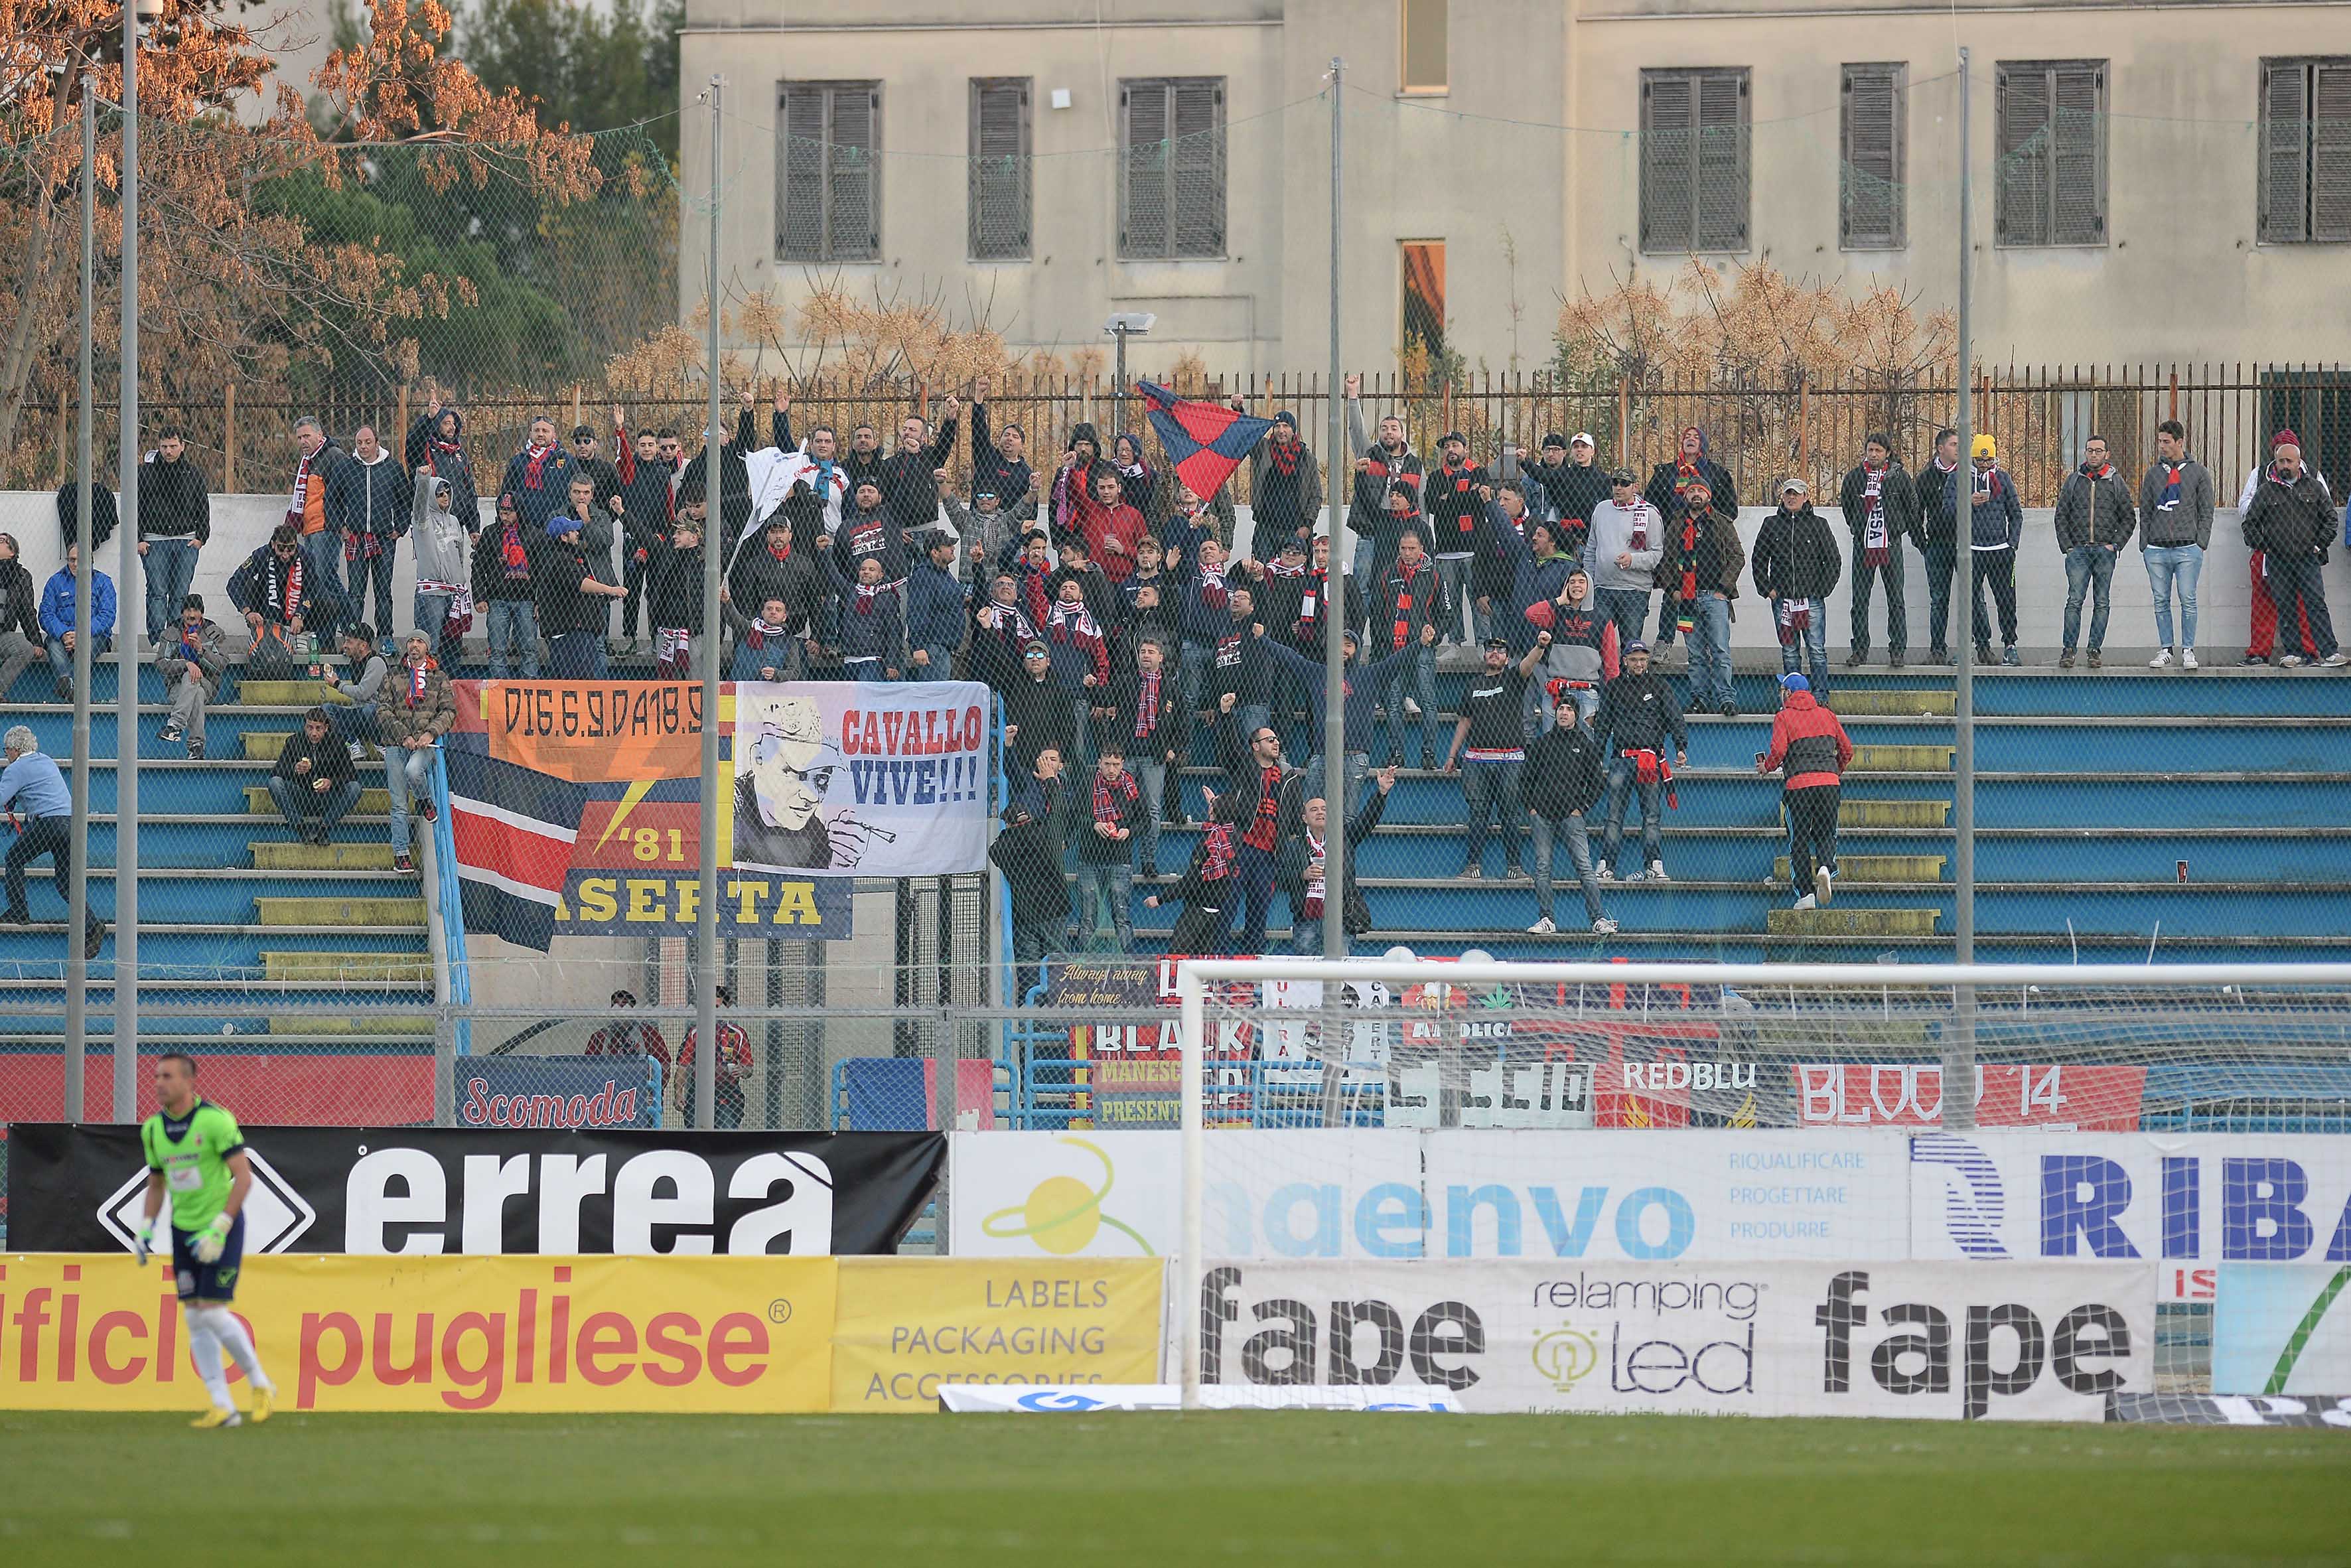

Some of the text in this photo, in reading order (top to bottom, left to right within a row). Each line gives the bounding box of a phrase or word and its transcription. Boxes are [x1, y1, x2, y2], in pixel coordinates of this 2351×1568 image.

[841, 705, 982, 756] CAVALLO
[851, 755, 977, 806] VIVE!!!
[1057, 987, 1086, 1006] from
[1060, 964, 1147, 985] Always away
[1096, 1019, 1246, 1052] BLAK
[463, 1078, 637, 1128] Scomoda
[1729, 1151, 1866, 1171] RIQUALIFICARE
[1730, 1186, 1848, 1204] PROGETTARE
[2040, 1155, 2351, 1262] RIB
[1731, 1221, 1830, 1239] PRODURRE
[986, 1279, 1108, 1309] LABELS
[1533, 1271, 1758, 1320] relamping
[296, 1265, 770, 1411] pugliese
[891, 1326, 1105, 1355] PACKAGING
[1200, 1266, 1486, 1391] fape
[1815, 1270, 2132, 1420] fape
[1612, 1320, 1754, 1394] led
